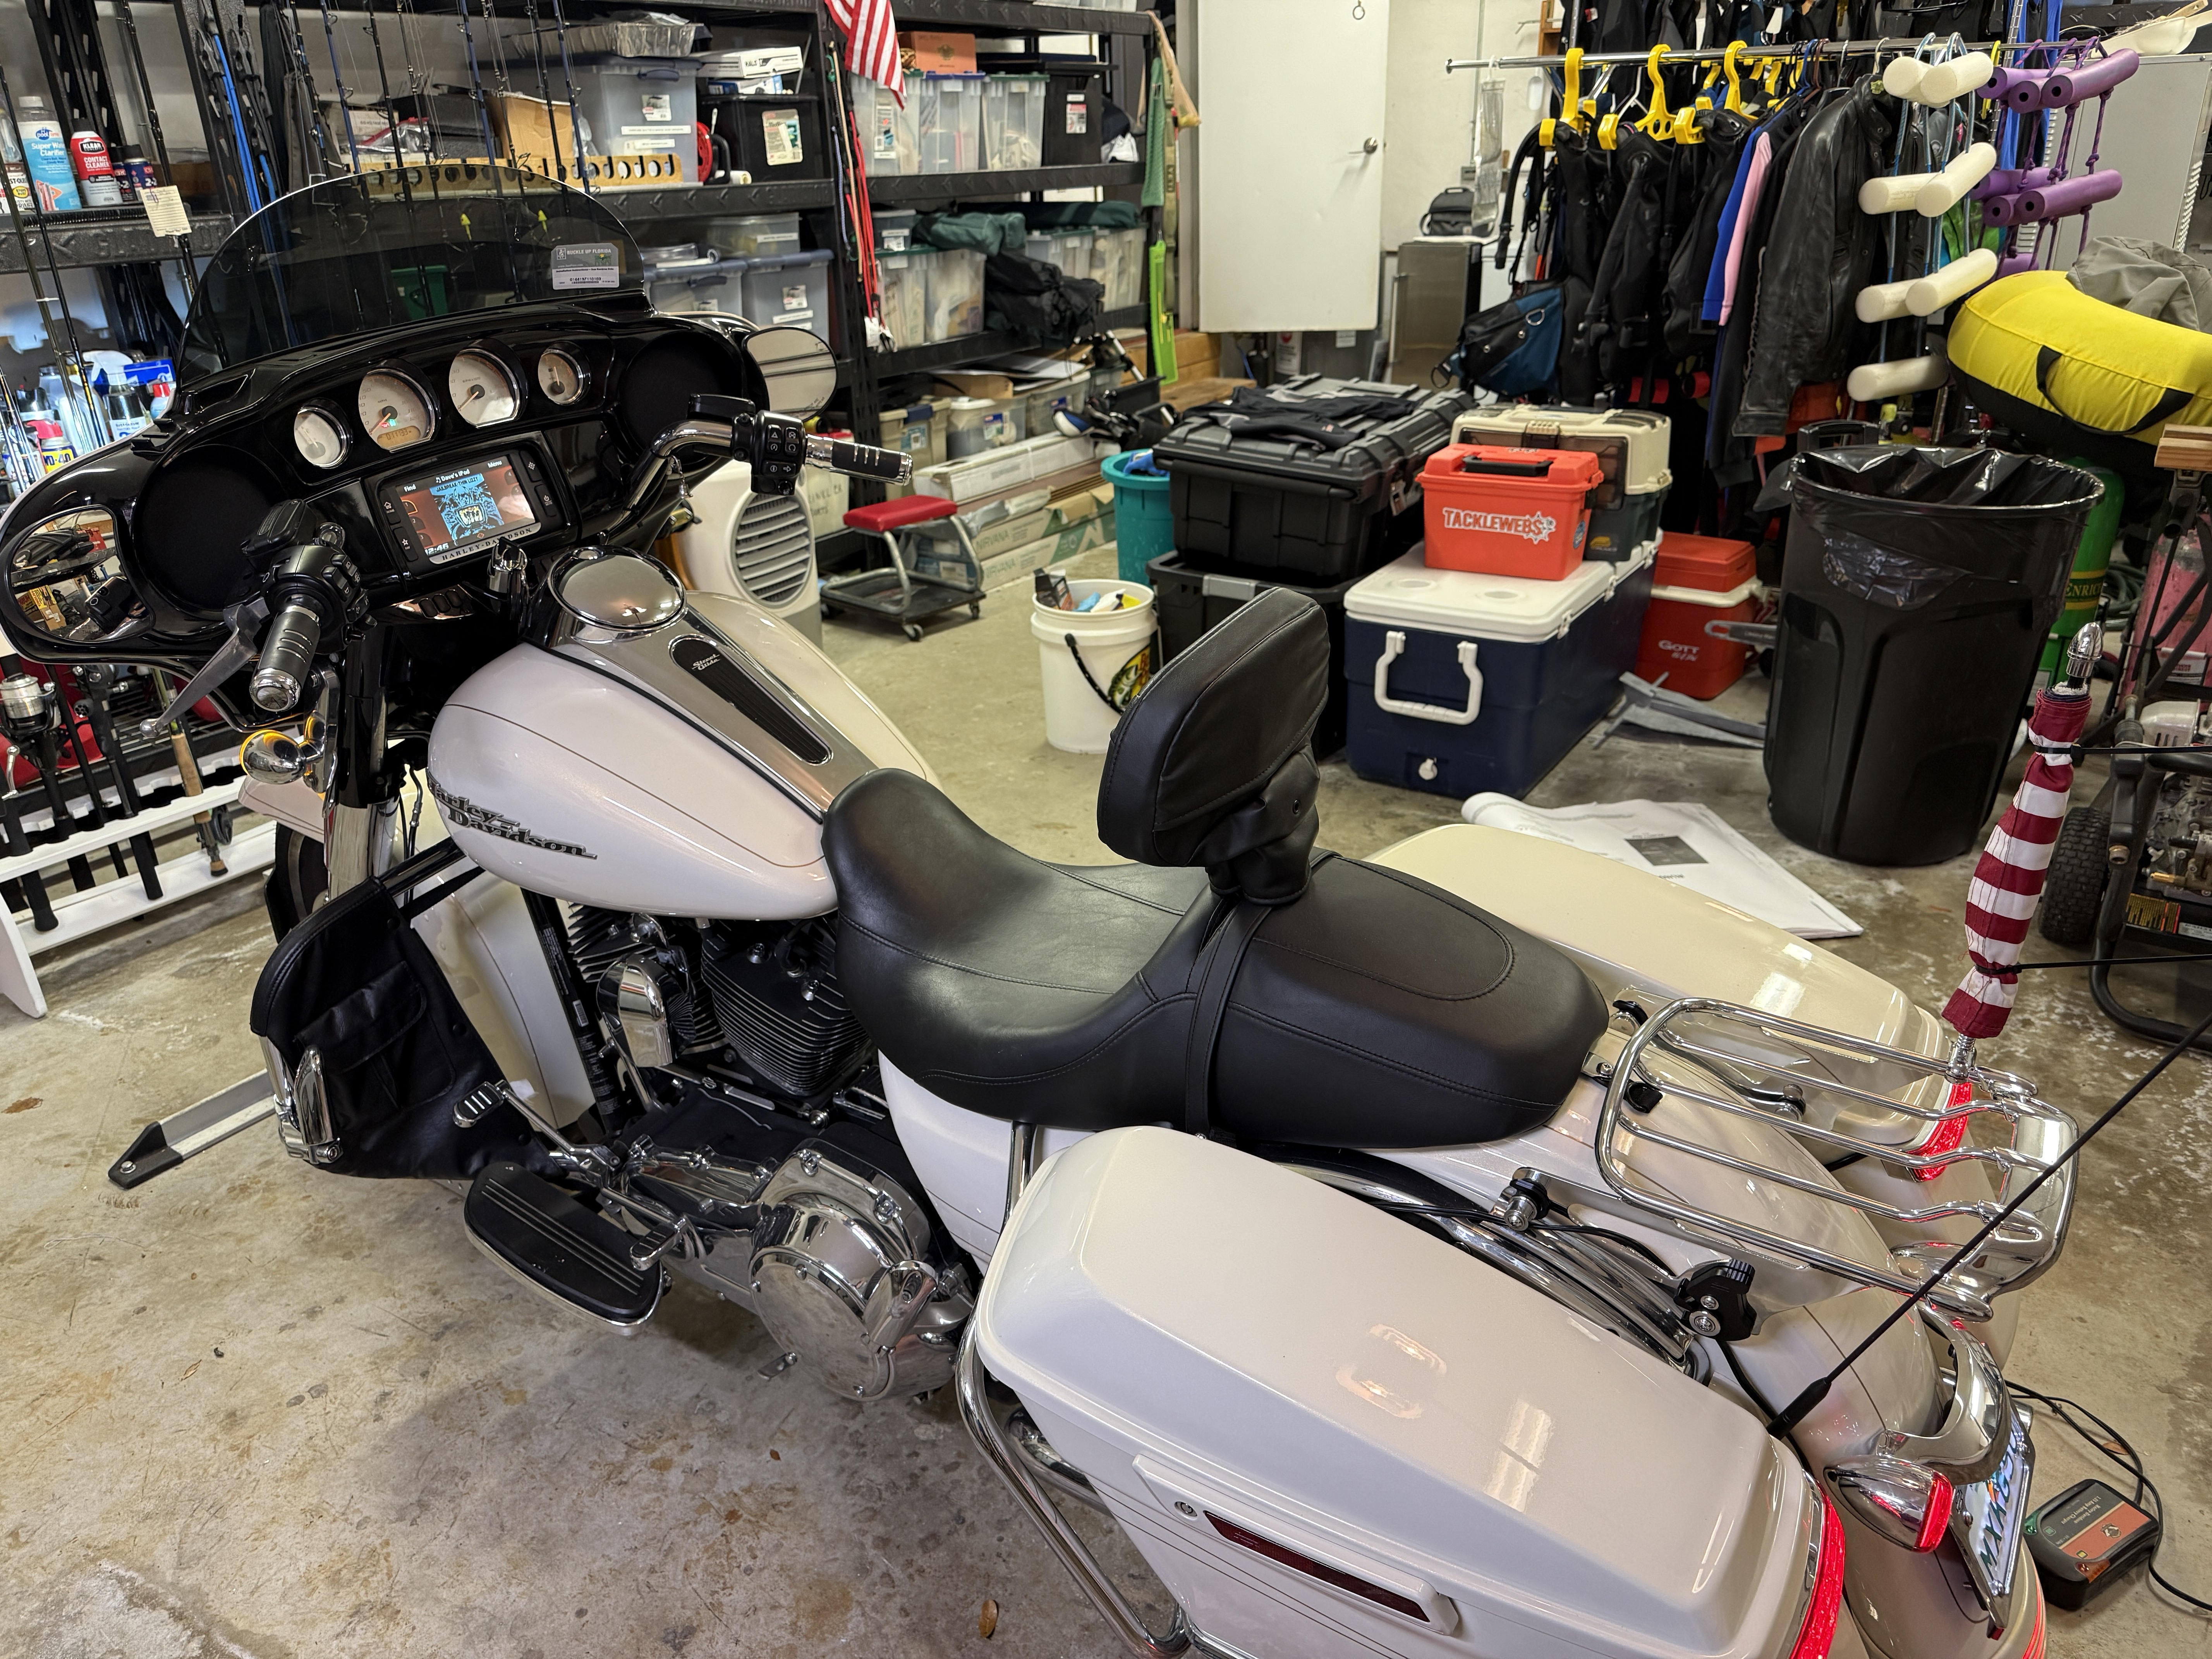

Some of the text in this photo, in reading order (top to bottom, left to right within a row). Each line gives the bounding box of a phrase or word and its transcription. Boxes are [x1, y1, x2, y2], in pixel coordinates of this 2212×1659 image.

[487, 460, 502, 468] Menu
[441, 469, 470, 482] Dave's iPod
[404, 484, 416, 493] Find
[1443, 508, 1544, 536] TACKLEWEBS
[442, 527, 532, 561] HARLEY-DADSON
[692, 654, 720, 670] Street
[697, 658, 720, 671] Glide
[448, 805, 598, 860] Davidson
